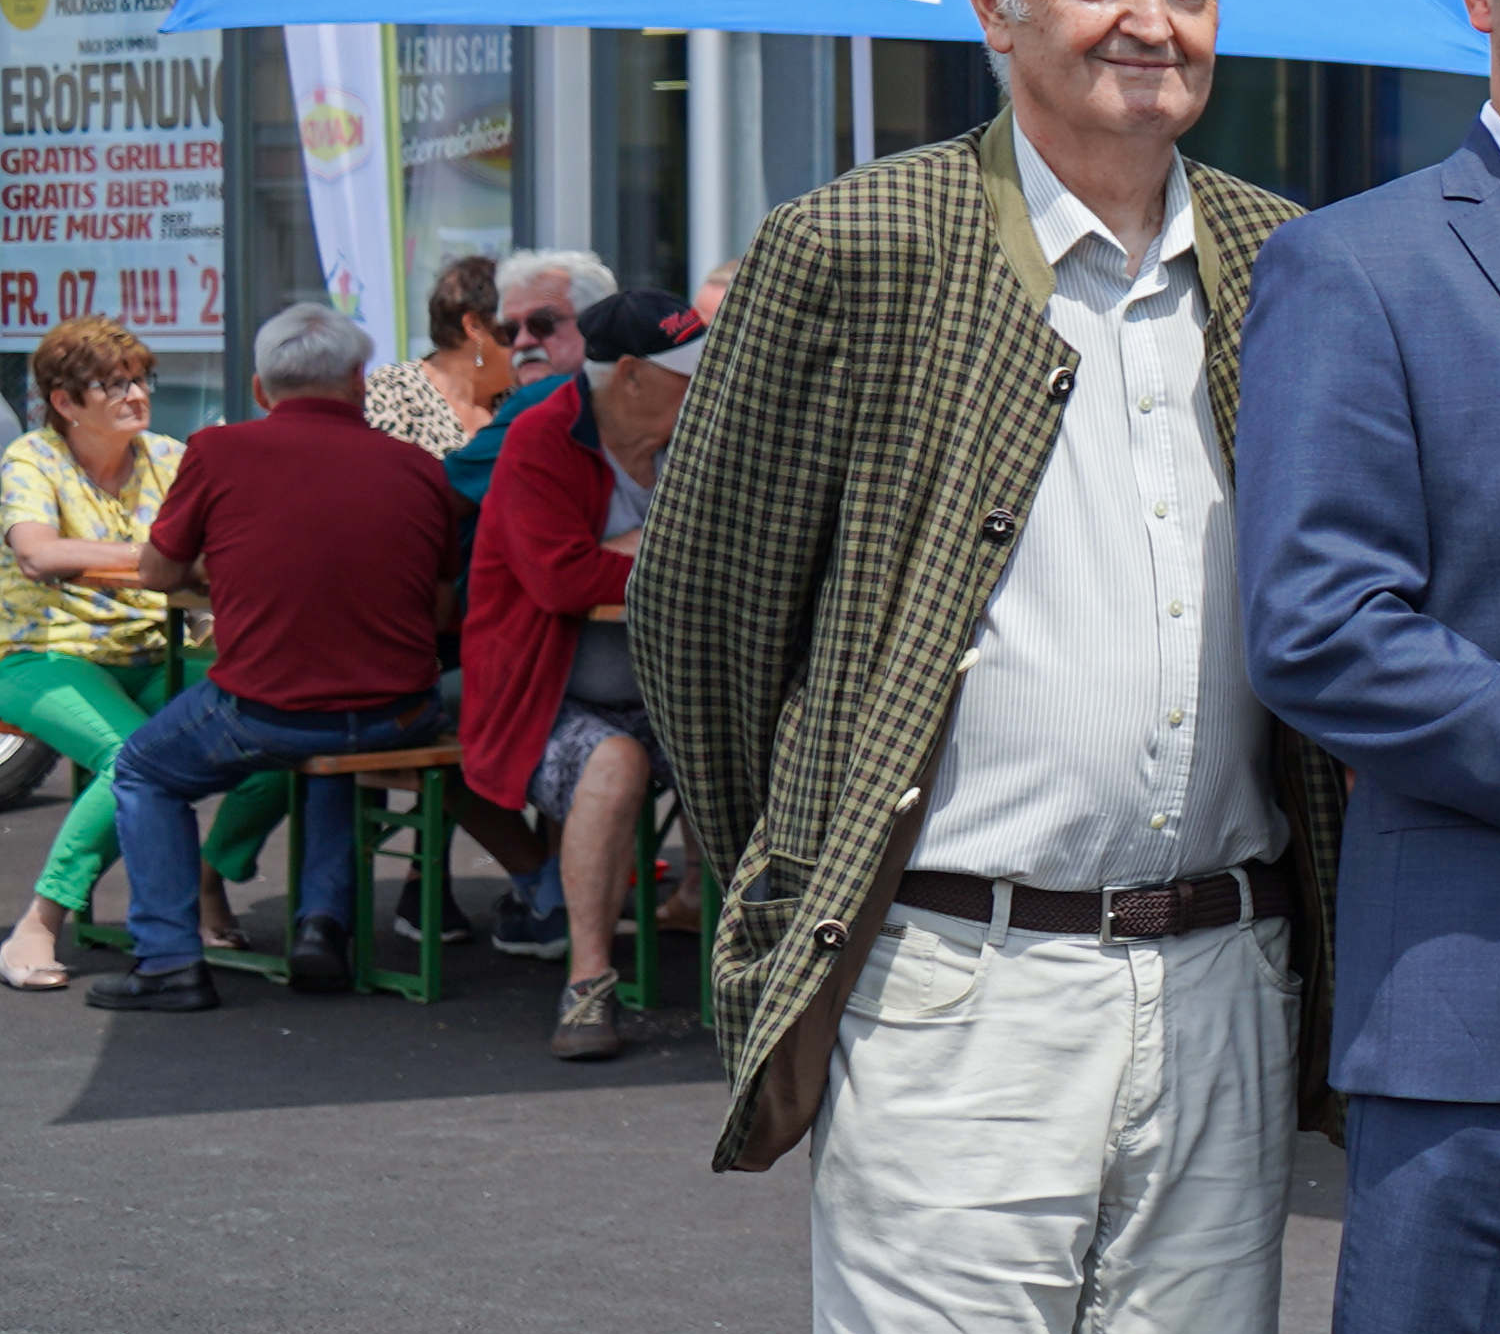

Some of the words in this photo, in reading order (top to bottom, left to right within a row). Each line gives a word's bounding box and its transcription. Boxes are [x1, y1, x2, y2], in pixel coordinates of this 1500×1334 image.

[3, 57, 224, 136] ERÖFFNUN
[0, 145, 98, 175] GRATIS
[105, 140, 224, 171] GRILLER
[1, 182, 98, 211] GRATIS
[106, 179, 170, 208] BIER
[2, 213, 58, 242] LIVE
[65, 212, 154, 241] MUSIK
[0, 269, 48, 327] FR.
[118, 267, 178, 327] JULI
